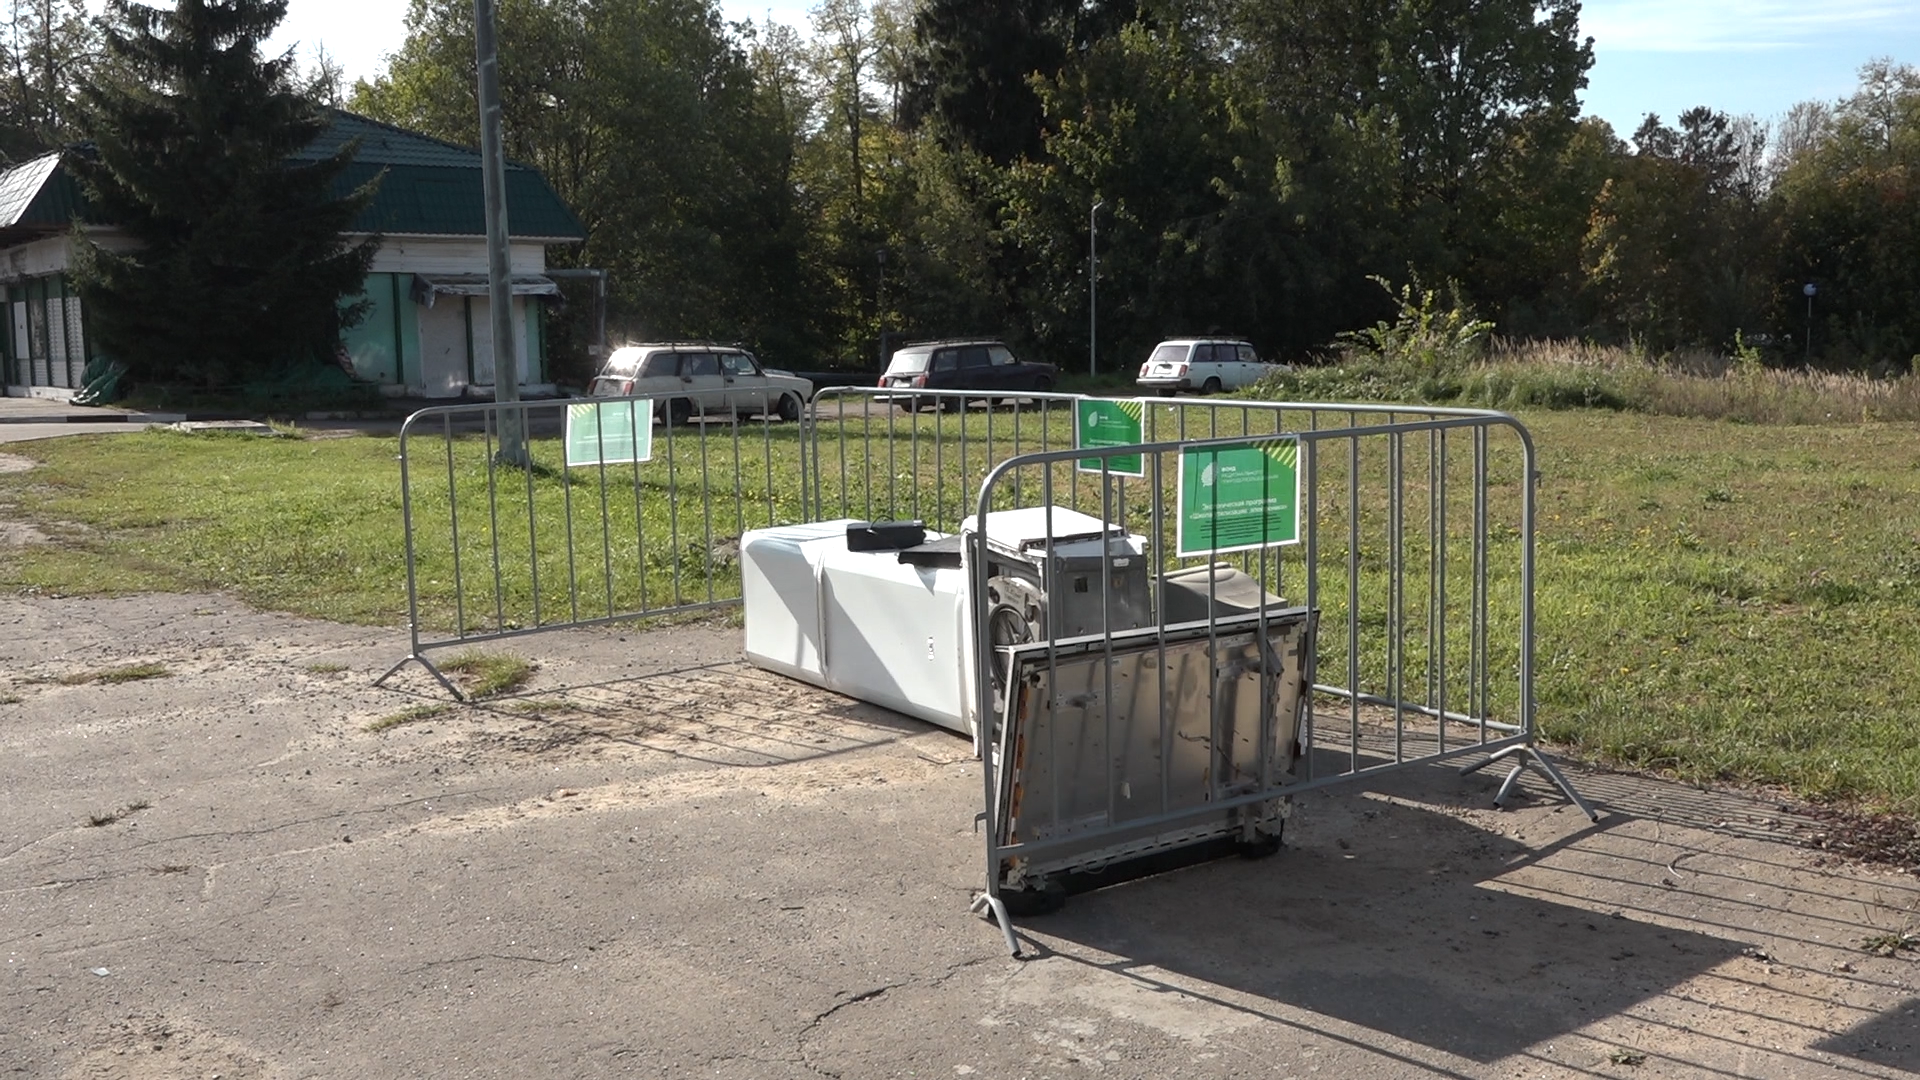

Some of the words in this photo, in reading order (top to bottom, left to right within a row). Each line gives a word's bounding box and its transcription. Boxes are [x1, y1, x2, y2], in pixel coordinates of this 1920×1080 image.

[1202, 501, 1245, 511] Экоогическая
[1213, 508, 1248, 517] тилизации:
[1250, 504, 1288, 513] элеконика»
